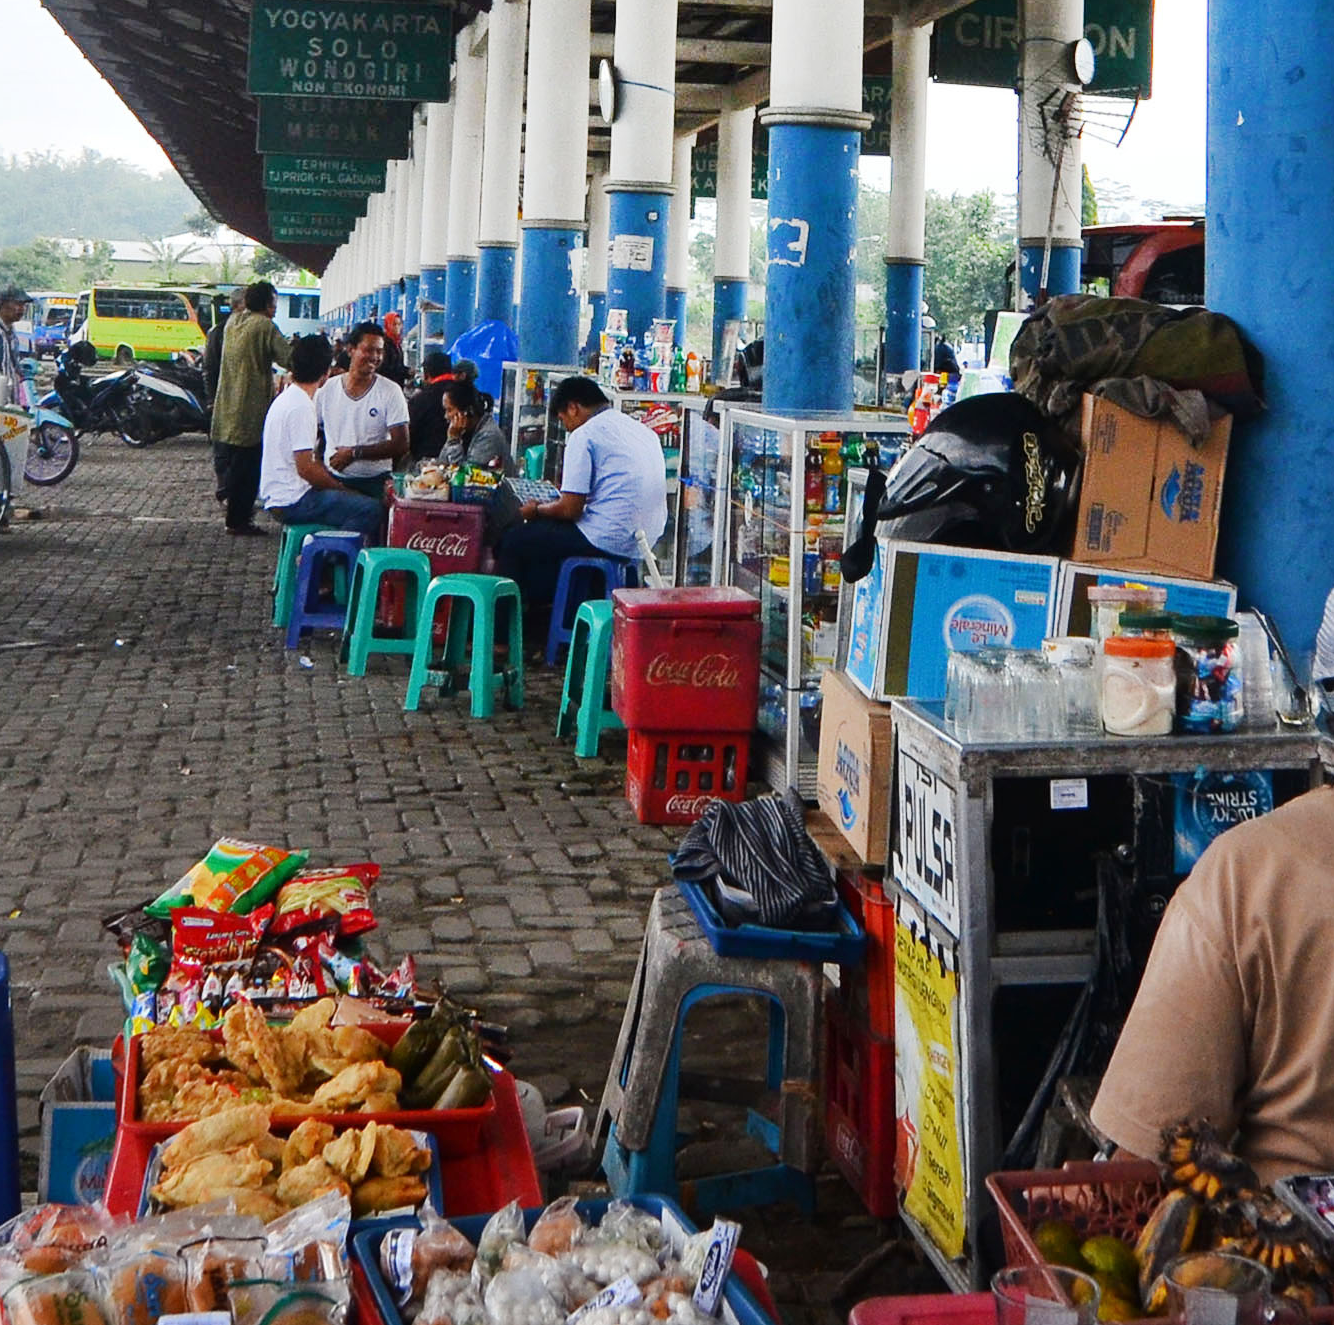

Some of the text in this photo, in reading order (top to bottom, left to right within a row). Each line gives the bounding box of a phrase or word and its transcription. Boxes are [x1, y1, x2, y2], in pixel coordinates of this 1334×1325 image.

[265, 9, 440, 34] YOGYAKARTA
[955, 12, 1136, 60] CIRON
[307, 37, 398, 59] SOLO
[280, 57, 422, 82] WONOGIRI
[292, 81, 406, 96] NON EKONOMI
[406, 530, 470, 557] Coca-Cola
[950, 619, 1007, 637] Minerale
[971, 632, 988, 645] Le
[646, 652, 740, 689] Coca-Cola
[1205, 789, 1258, 807] STRIKE
[1211, 807, 1256, 823] LUCKY
